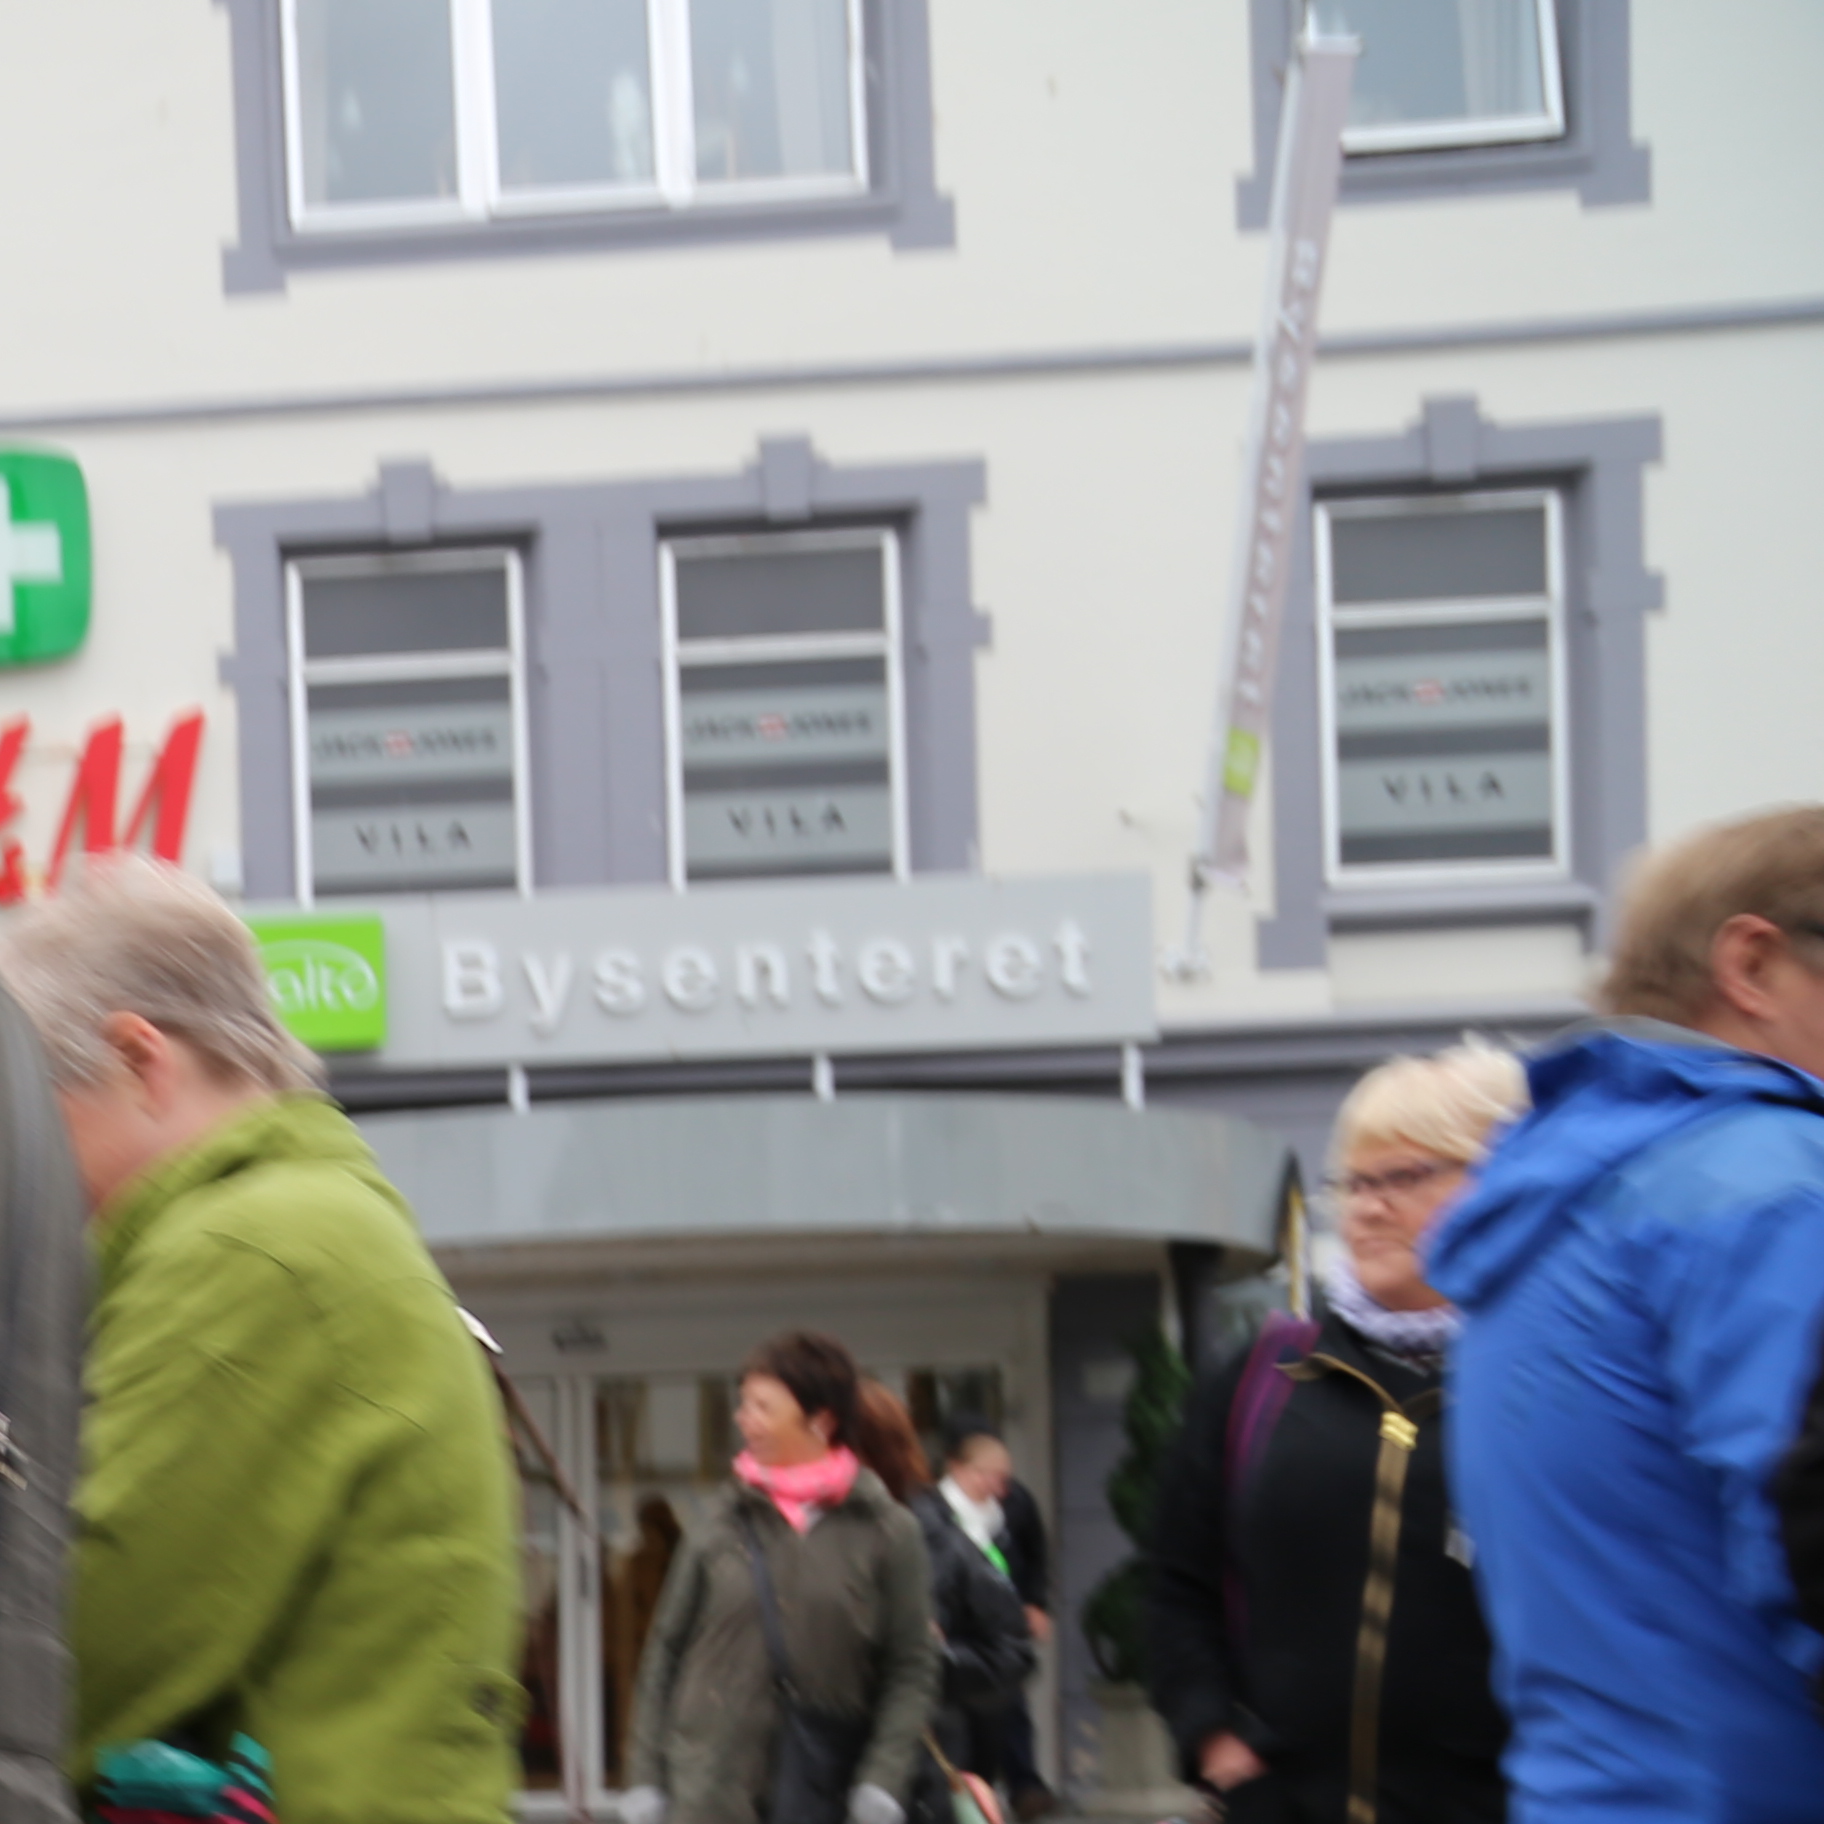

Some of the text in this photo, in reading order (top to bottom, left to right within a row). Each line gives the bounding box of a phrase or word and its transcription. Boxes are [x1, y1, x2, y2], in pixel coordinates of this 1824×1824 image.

[1380, 768, 1506, 806] VILA
[354, 818, 472, 856] VILA
[726, 801, 848, 842] VILA
[264, 950, 379, 1014] alto
[441, 920, 1090, 1034] Bysenteret
